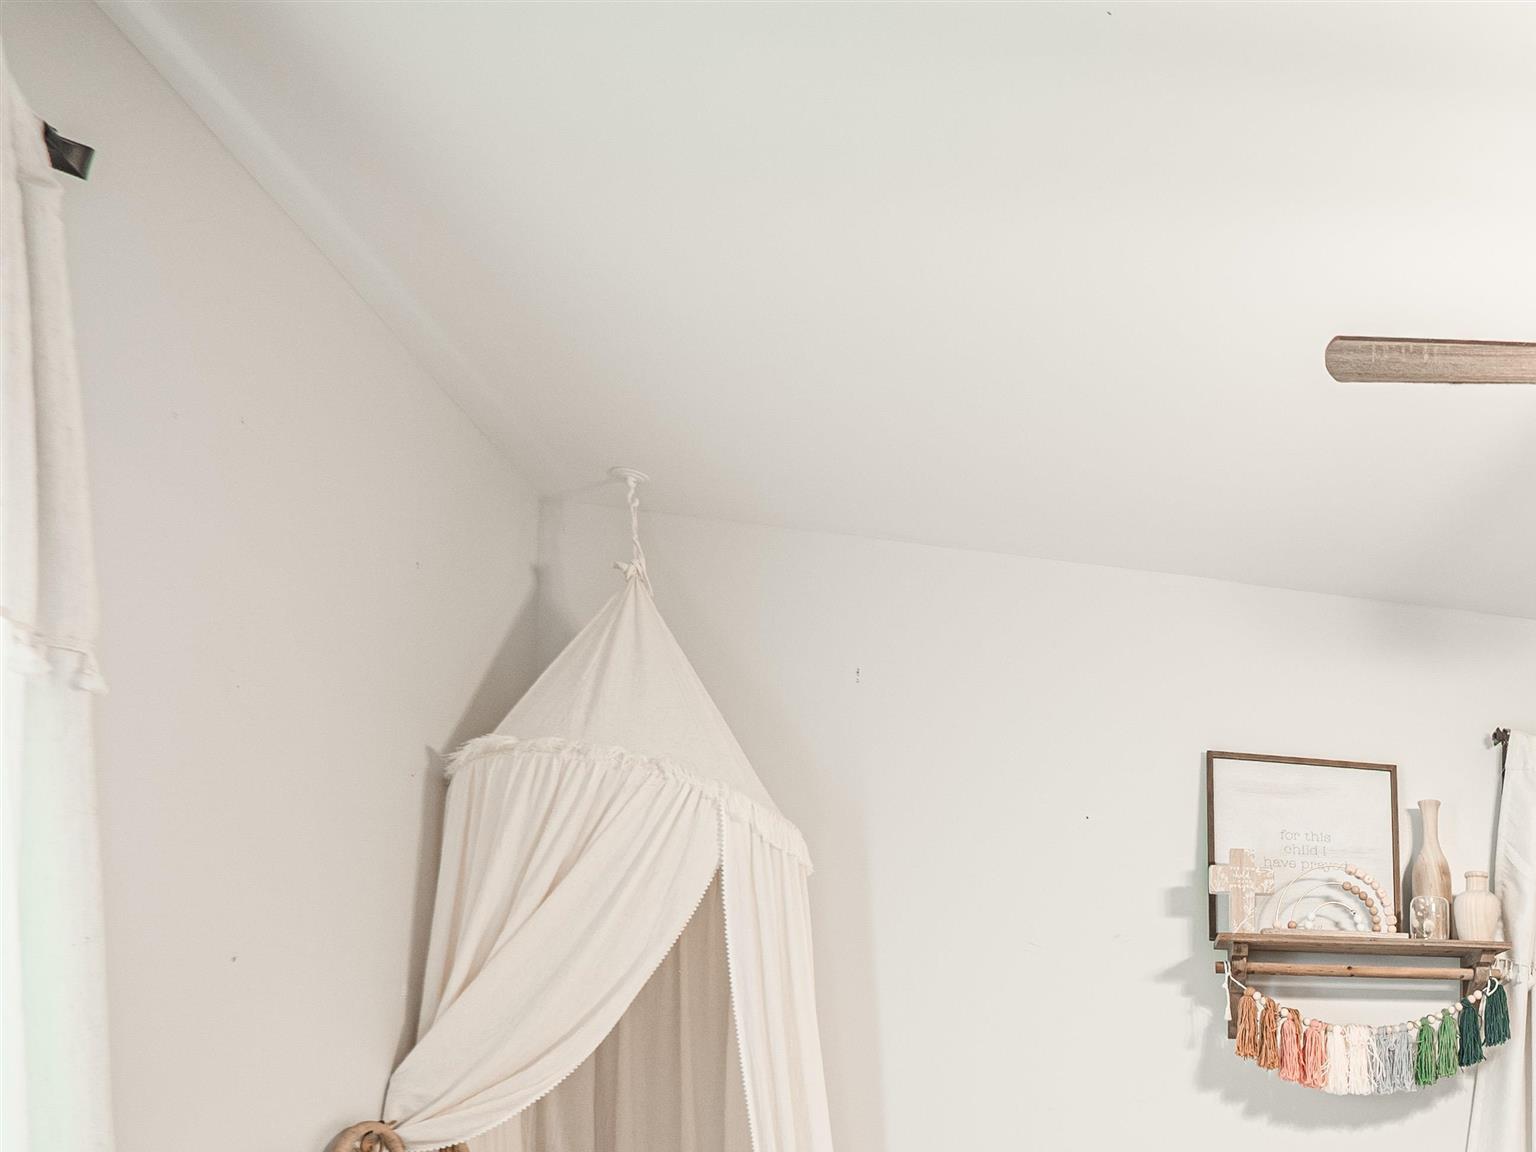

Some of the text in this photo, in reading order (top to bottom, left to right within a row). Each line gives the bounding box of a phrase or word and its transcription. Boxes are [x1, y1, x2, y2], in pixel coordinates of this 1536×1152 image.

[1280, 829, 1332, 843] for this
[1283, 844, 1318, 856] child
[1263, 856, 1297, 869] have
